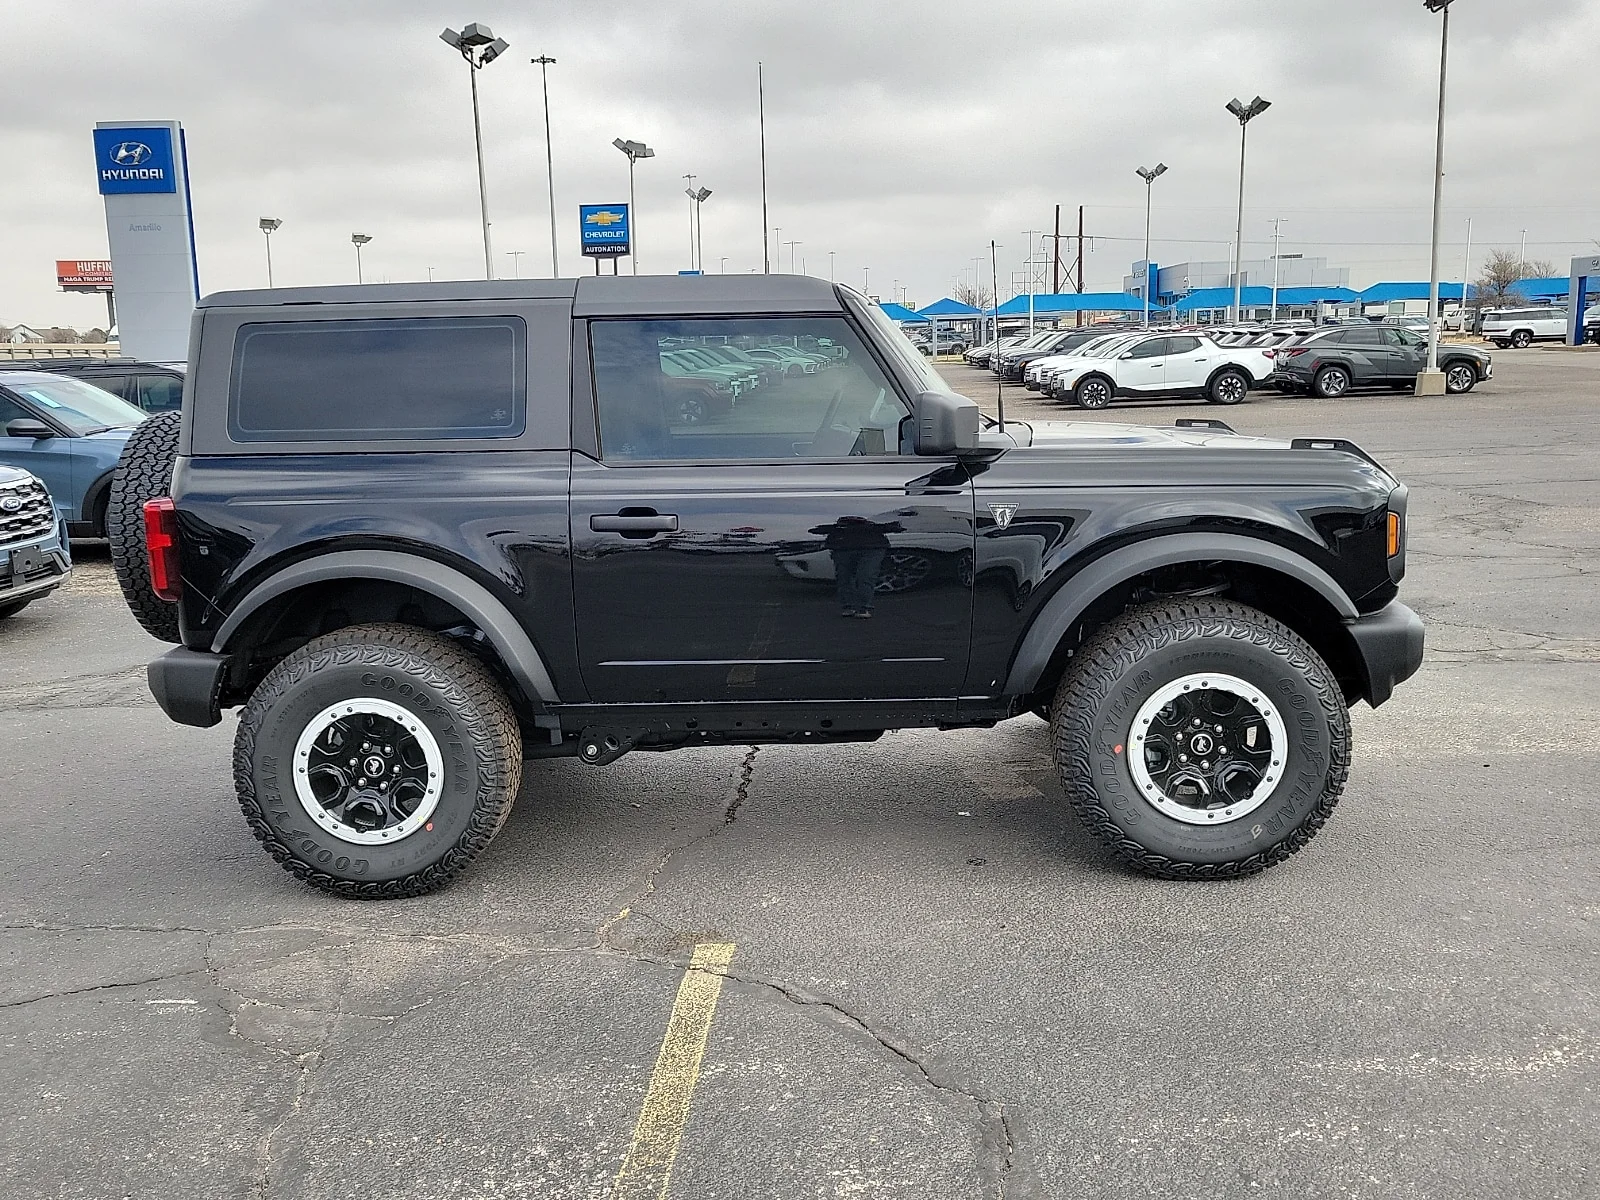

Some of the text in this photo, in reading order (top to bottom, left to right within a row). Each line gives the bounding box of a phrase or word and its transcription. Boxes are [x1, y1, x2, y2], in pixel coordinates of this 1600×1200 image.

[102, 168, 164, 180] HYUNDAI
[128, 223, 162, 232] Amarillo
[584, 231, 625, 239] CHEVROLET
[585, 245, 626, 253] AUTONATION
[76, 261, 113, 271] HUFFIN
